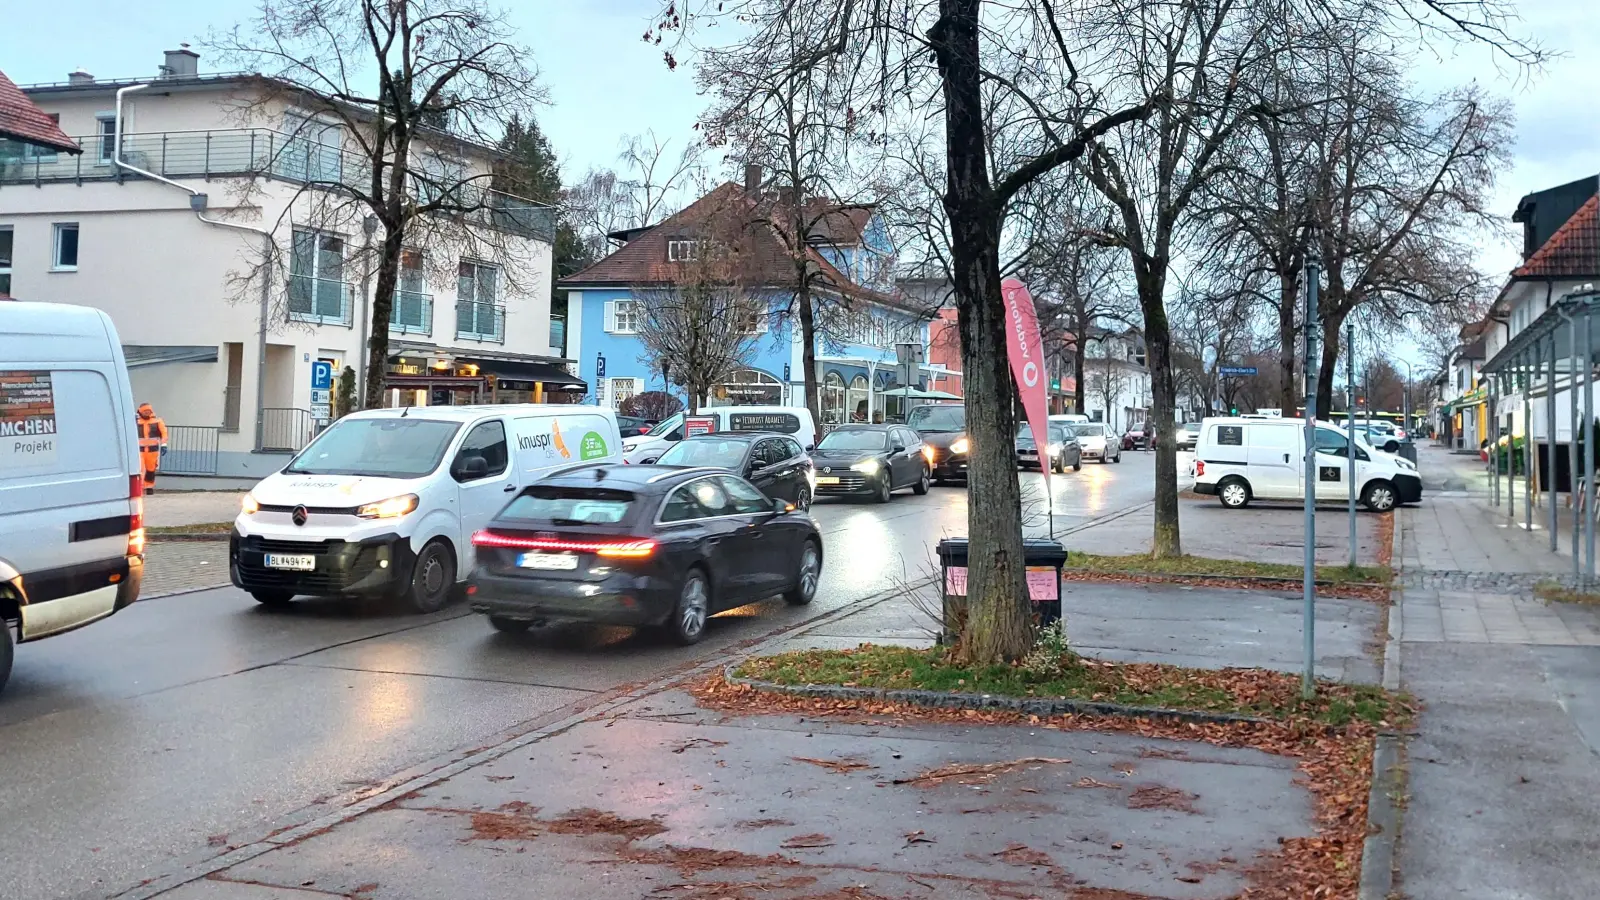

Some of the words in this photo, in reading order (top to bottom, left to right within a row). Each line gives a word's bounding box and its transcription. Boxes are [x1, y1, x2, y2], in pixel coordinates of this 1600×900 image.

[315, 365, 327, 386] P
[1, 419, 54, 435] MCHEN
[15, 440, 52, 454] Projekt
[516, 433, 551, 450] knuspr
